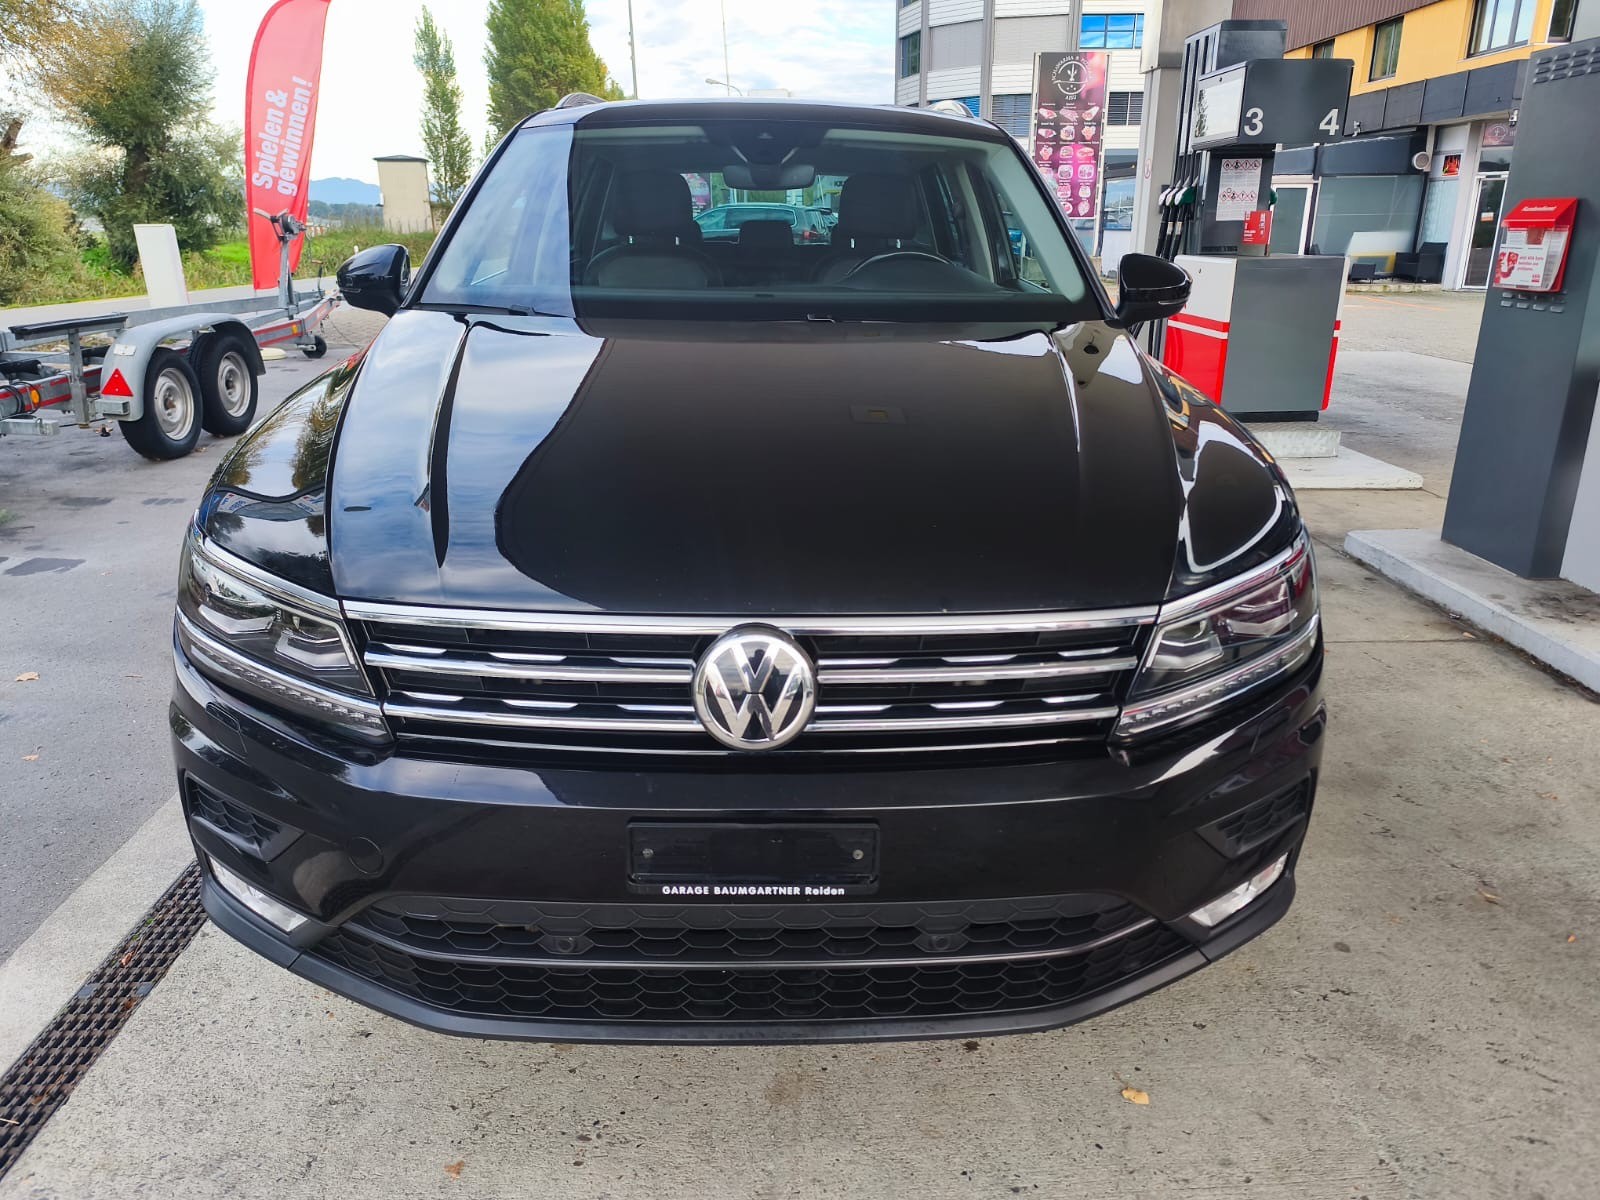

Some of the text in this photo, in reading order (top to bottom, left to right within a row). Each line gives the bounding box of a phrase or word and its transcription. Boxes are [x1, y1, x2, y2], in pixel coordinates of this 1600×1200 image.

[252, 89, 288, 189] Spielen &
[277, 76, 313, 197] gewinnen!
[1243, 107, 1264, 136] 3
[1318, 108, 1340, 136] 4
[701, 636, 806, 742] VW
[662, 885, 710, 896] GARAGE
[714, 885, 801, 896] BAUMGARTNER
